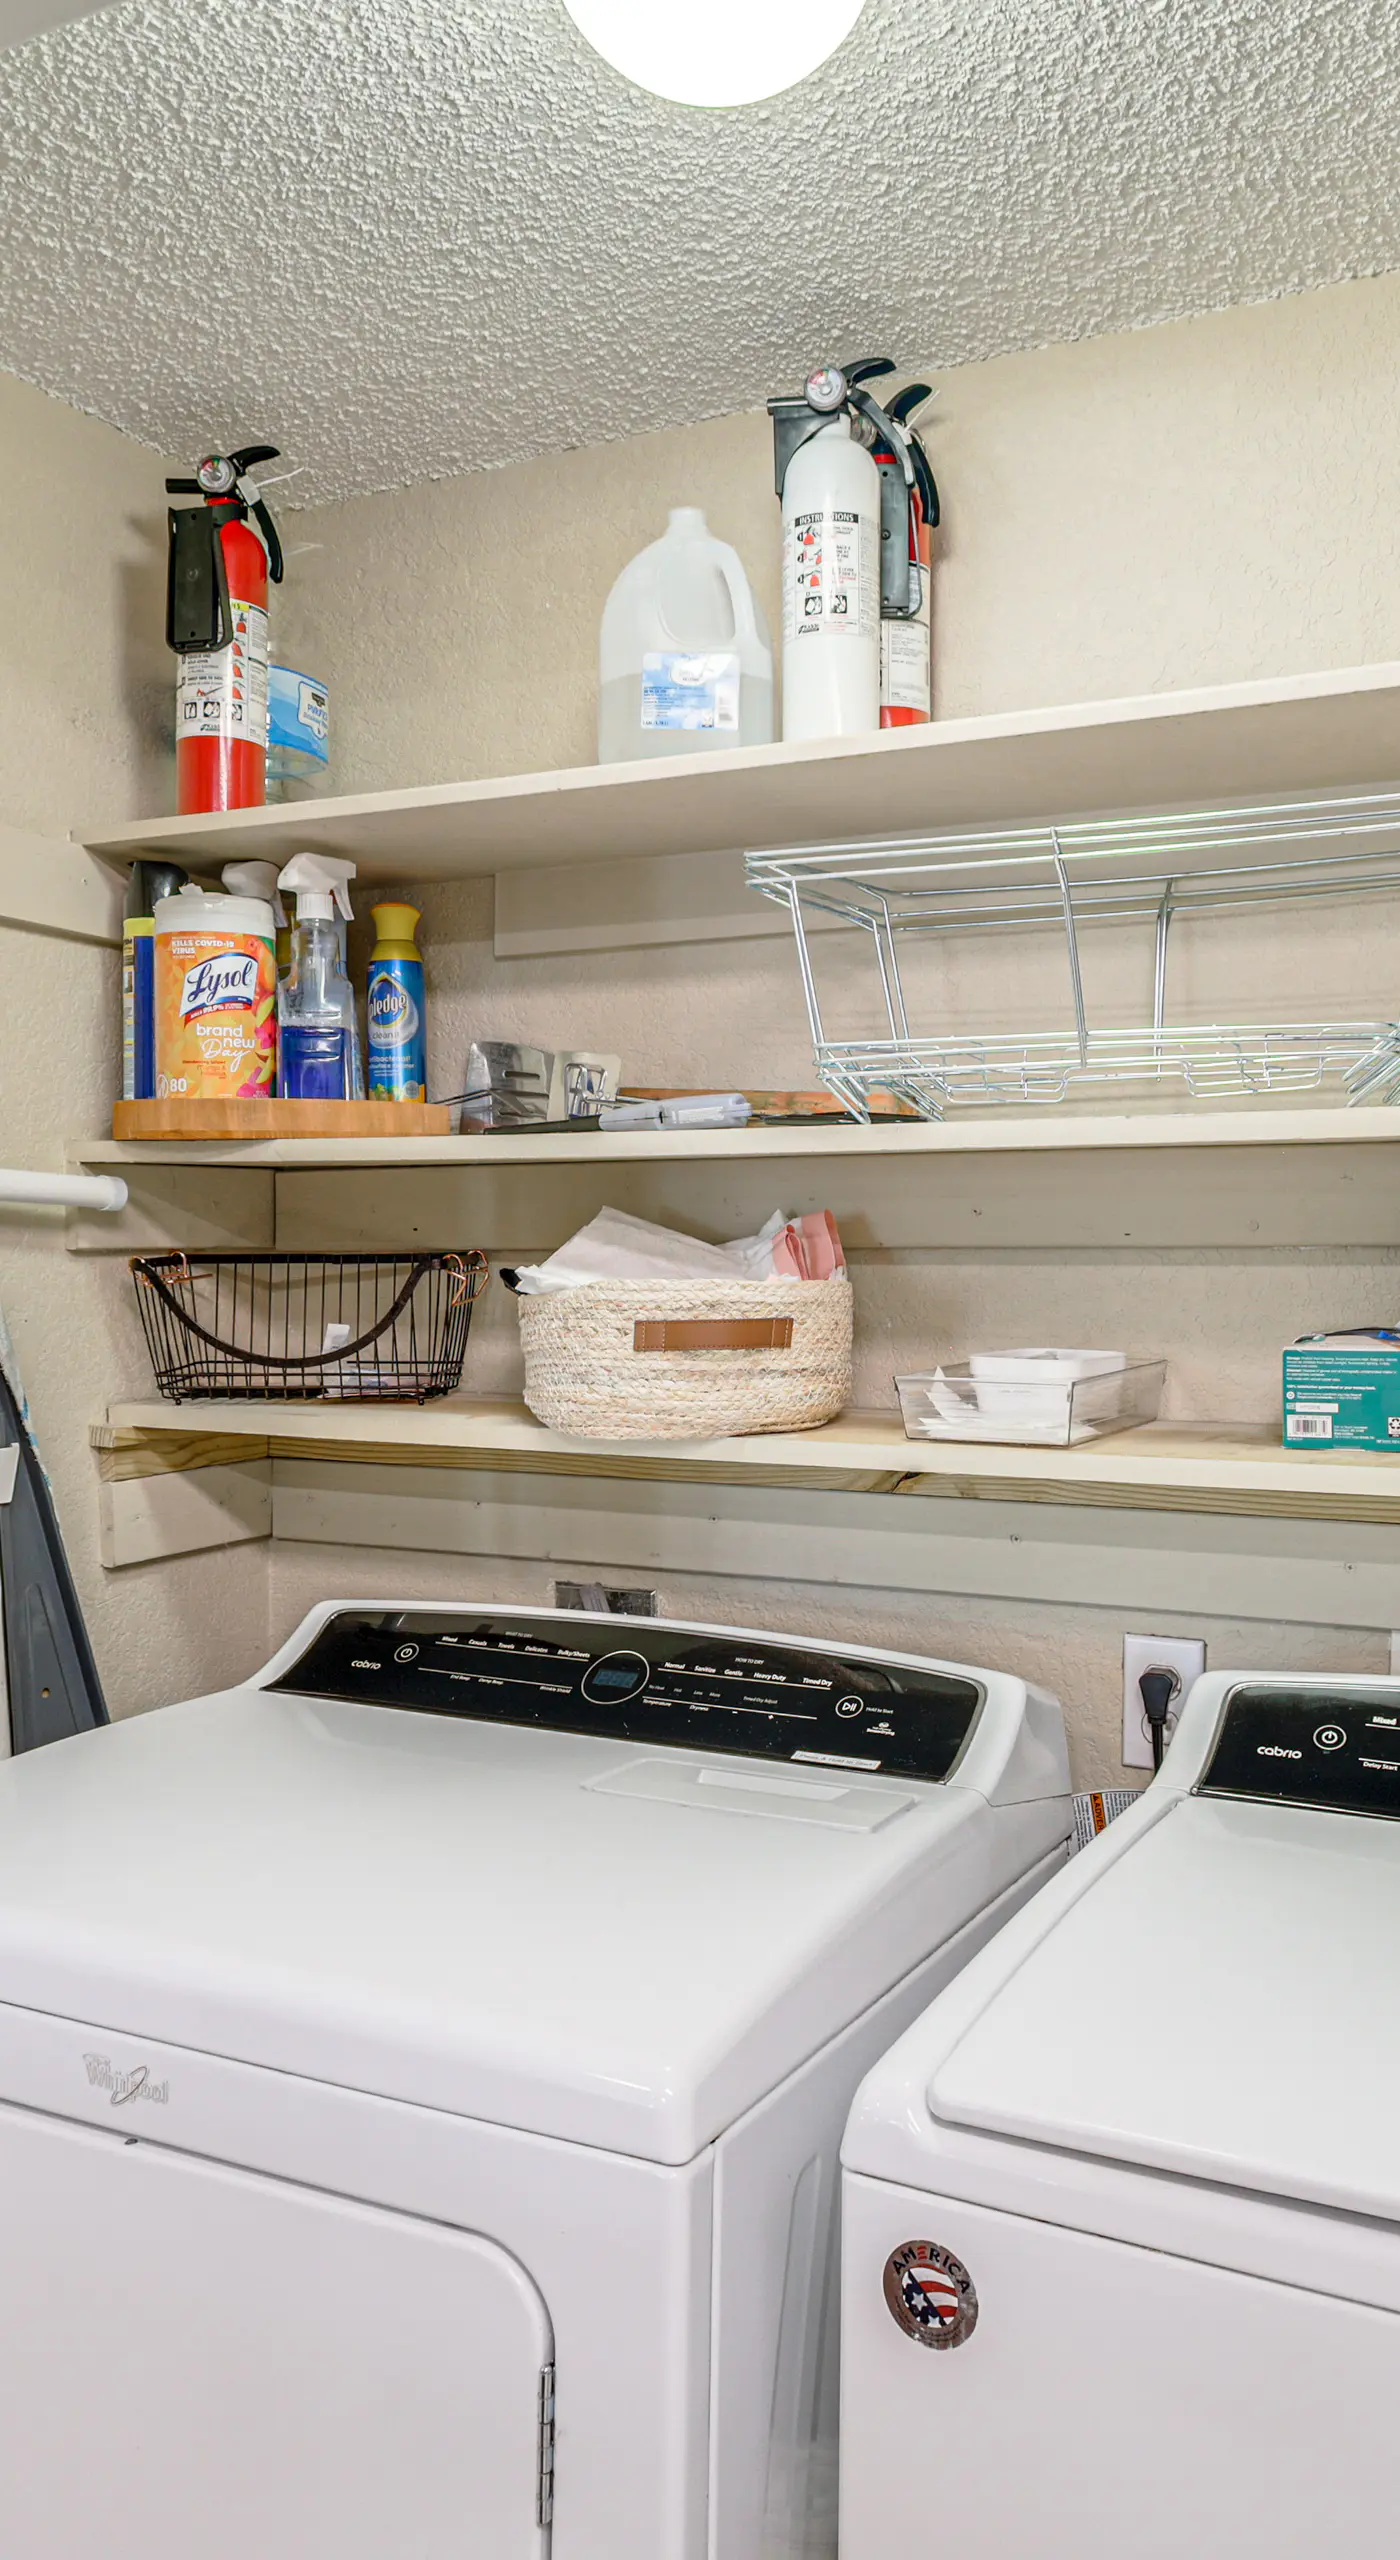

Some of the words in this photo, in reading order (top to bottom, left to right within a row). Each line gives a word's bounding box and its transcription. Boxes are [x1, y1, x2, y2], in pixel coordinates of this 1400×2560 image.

[799, 512, 854, 525] INSTRUIONS
[172, 939, 193, 947] KILLS
[195, 940, 235, 948] COVID-19
[187, 960, 253, 1003] Lysol
[369, 994, 406, 1018] pledge
[196, 1023, 243, 1037] brand
[223, 1037, 256, 1048] new
[201, 1038, 252, 1072] Day
[170, 1078, 187, 1092] 80
[664, 1662, 686, 1670] Normal
[694, 1665, 716, 1674] Sanitize
[753, 1672, 771, 1681] Heavy
[771, 1674, 787, 1682] Duty
[802, 1677, 821, 1685] Timed
[821, 1679, 833, 1687] Dry
[1372, 1716, 1398, 1726] Mixed
[1256, 1746, 1302, 1759] cabrio
[1362, 1761, 1382, 1770] Delay
[892, 2245, 970, 2294] AMERICA
